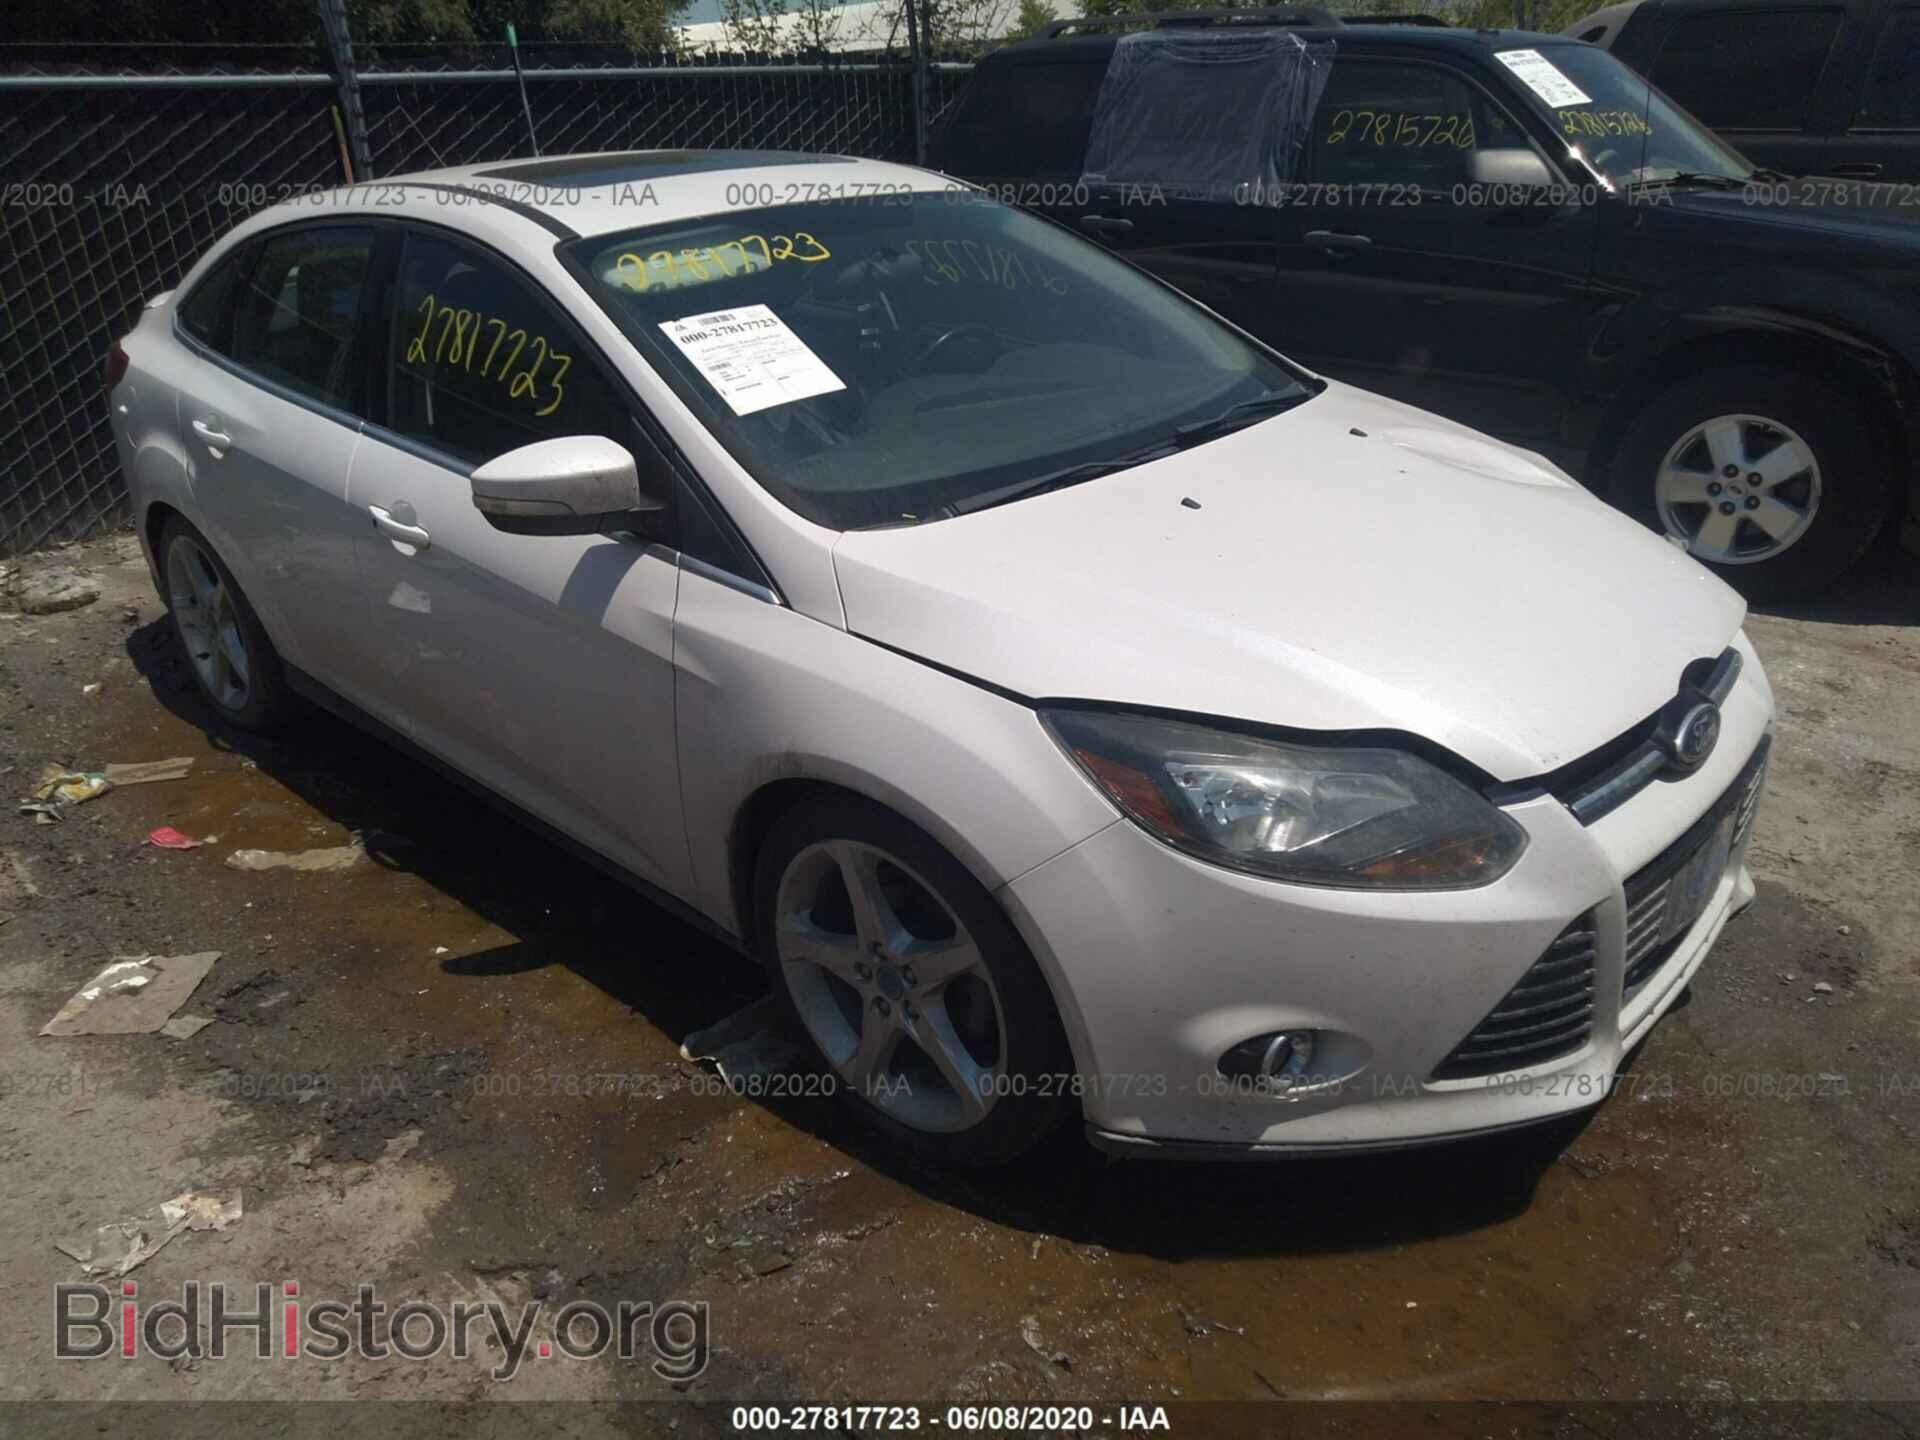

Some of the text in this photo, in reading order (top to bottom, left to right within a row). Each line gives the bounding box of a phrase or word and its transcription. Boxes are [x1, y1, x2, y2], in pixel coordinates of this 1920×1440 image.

[1327, 105, 1477, 150] 27815726
[616, 232, 831, 293] 27817723
[407, 294, 572, 416] 27817723
[680, 317, 778, 344] 000-27817723
